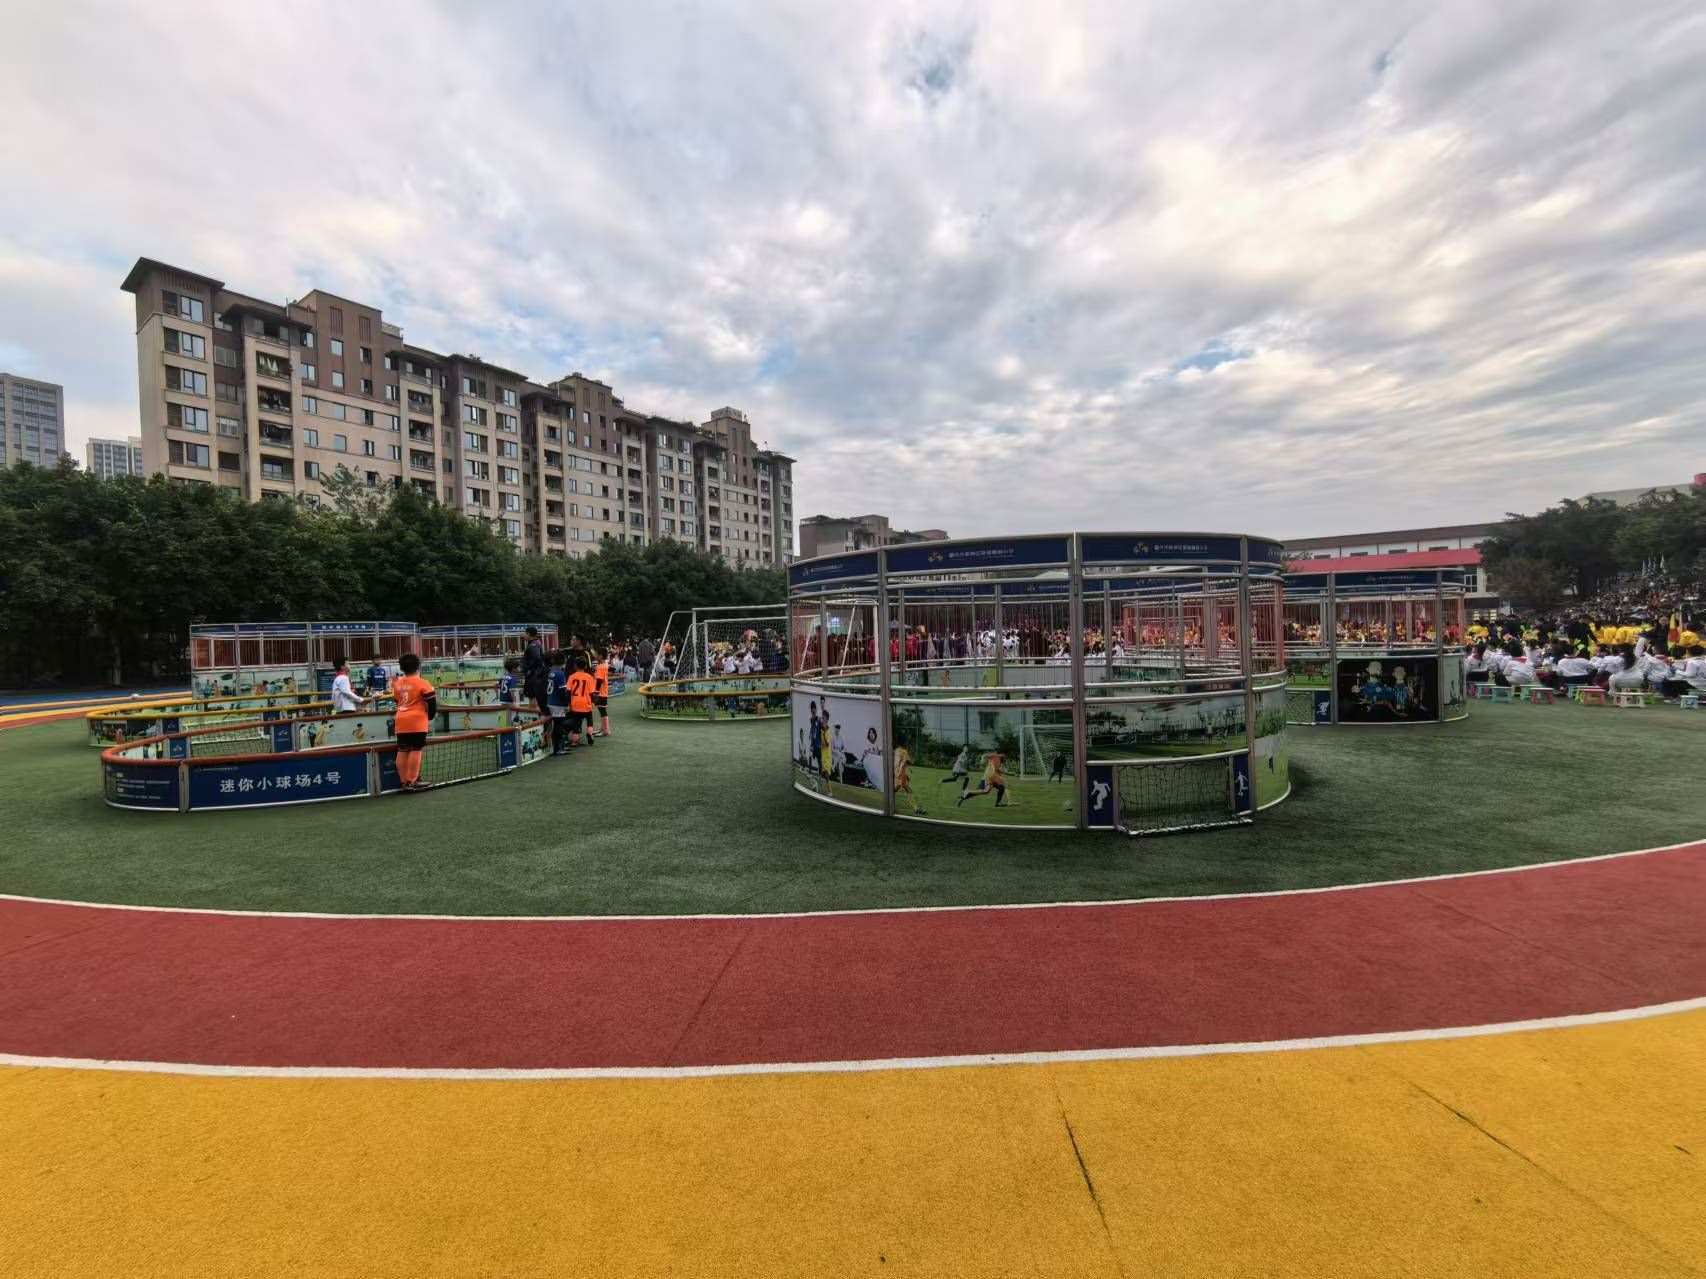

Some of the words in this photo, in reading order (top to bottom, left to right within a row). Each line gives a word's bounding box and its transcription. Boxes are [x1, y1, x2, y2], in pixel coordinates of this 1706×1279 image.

[572, 679, 587, 697] 21
[219, 771, 342, 793] 迷你小球场4号
